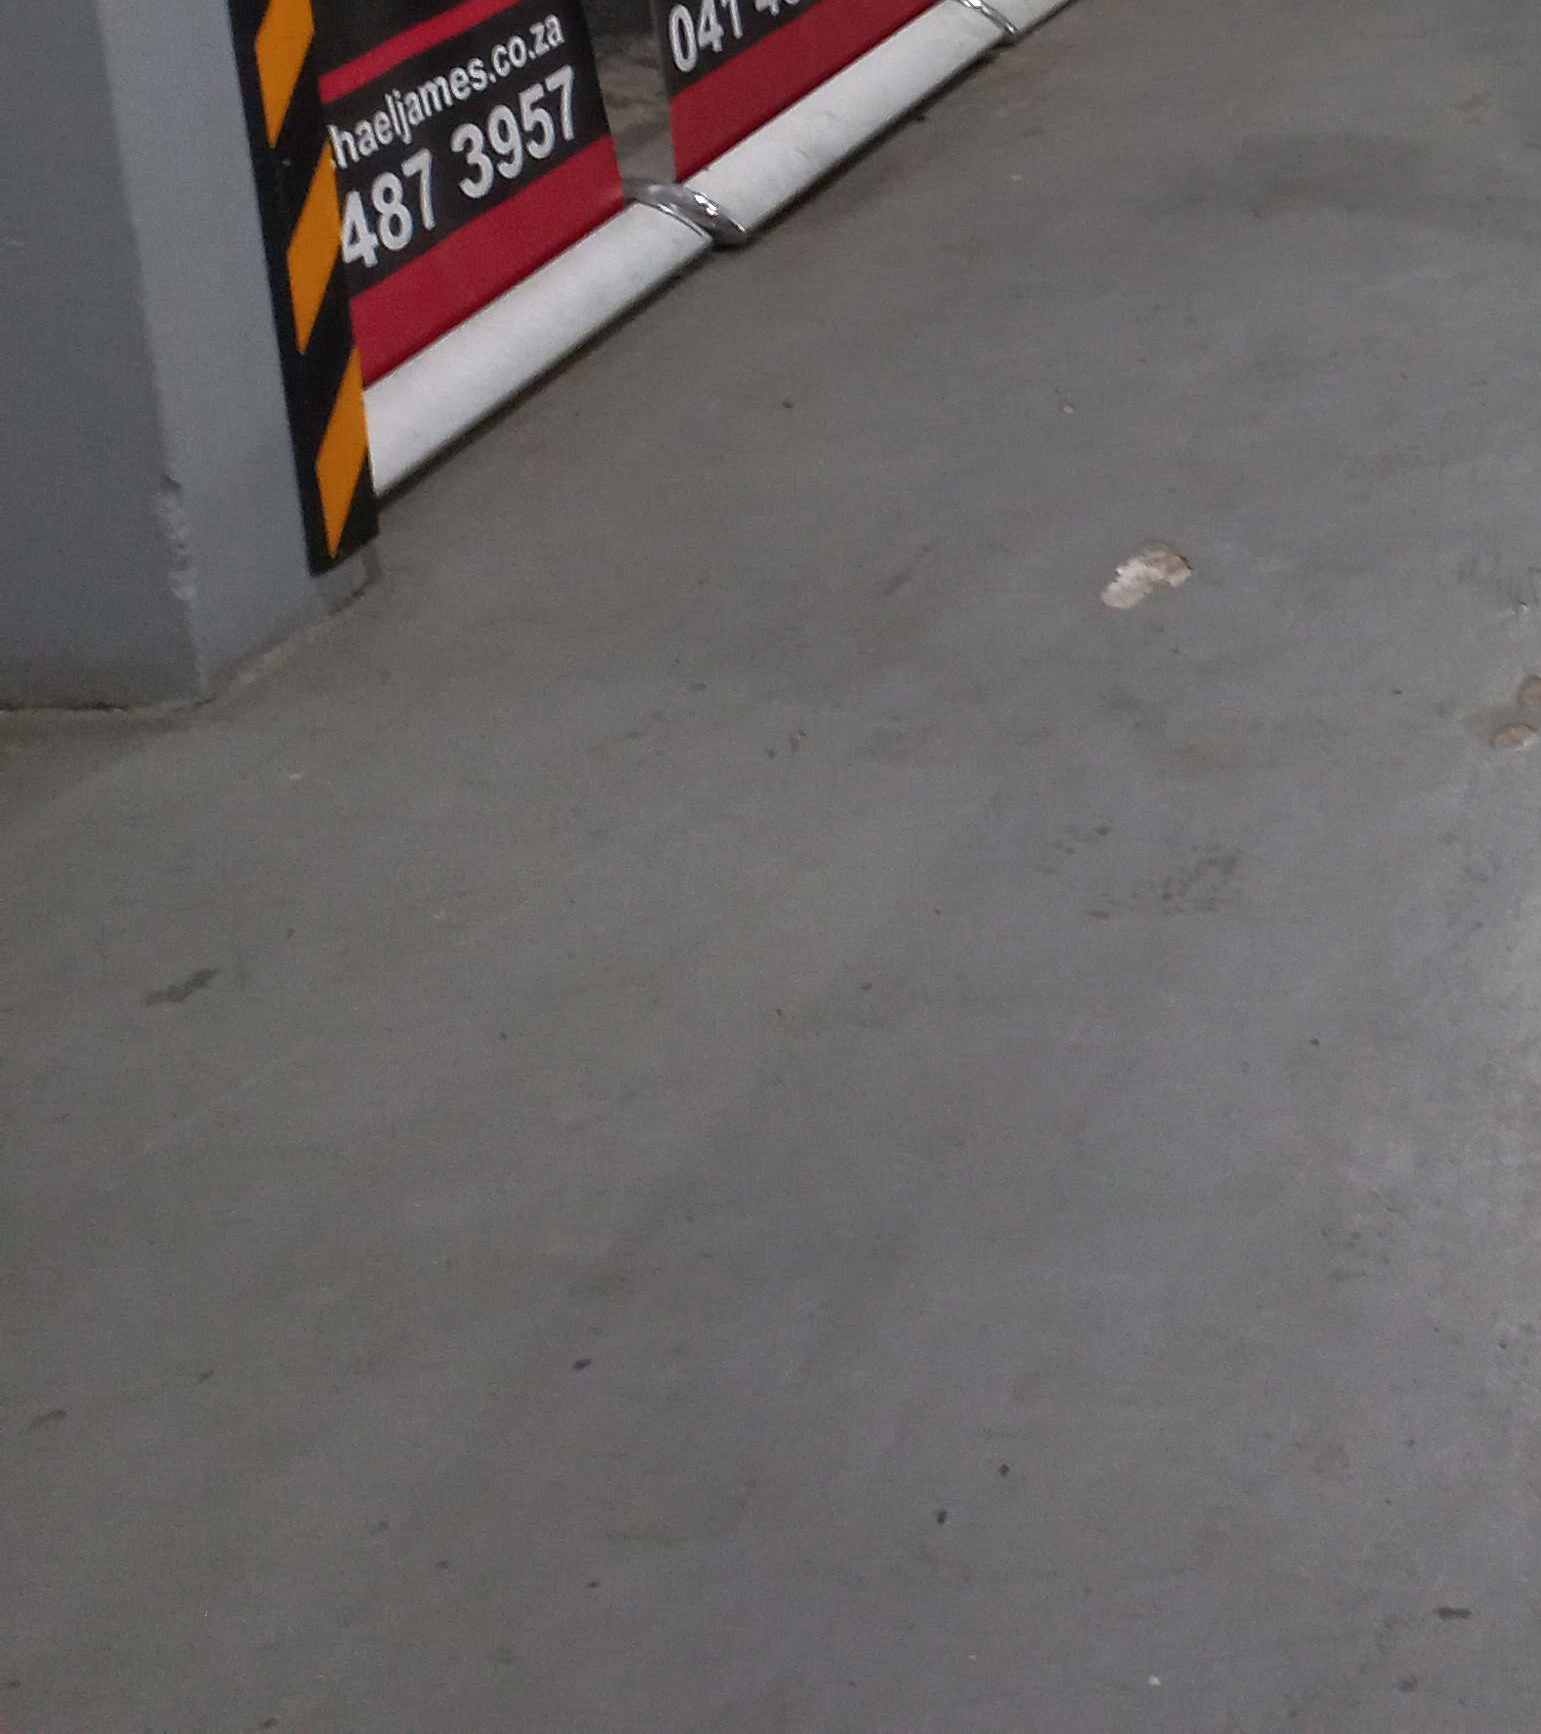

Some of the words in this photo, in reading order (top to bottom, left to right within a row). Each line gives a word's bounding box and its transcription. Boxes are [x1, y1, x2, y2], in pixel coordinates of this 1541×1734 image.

[326, 13, 565, 169] haeljames.co.za
[341, 147, 436, 268] 487
[451, 65, 575, 199] 3957
